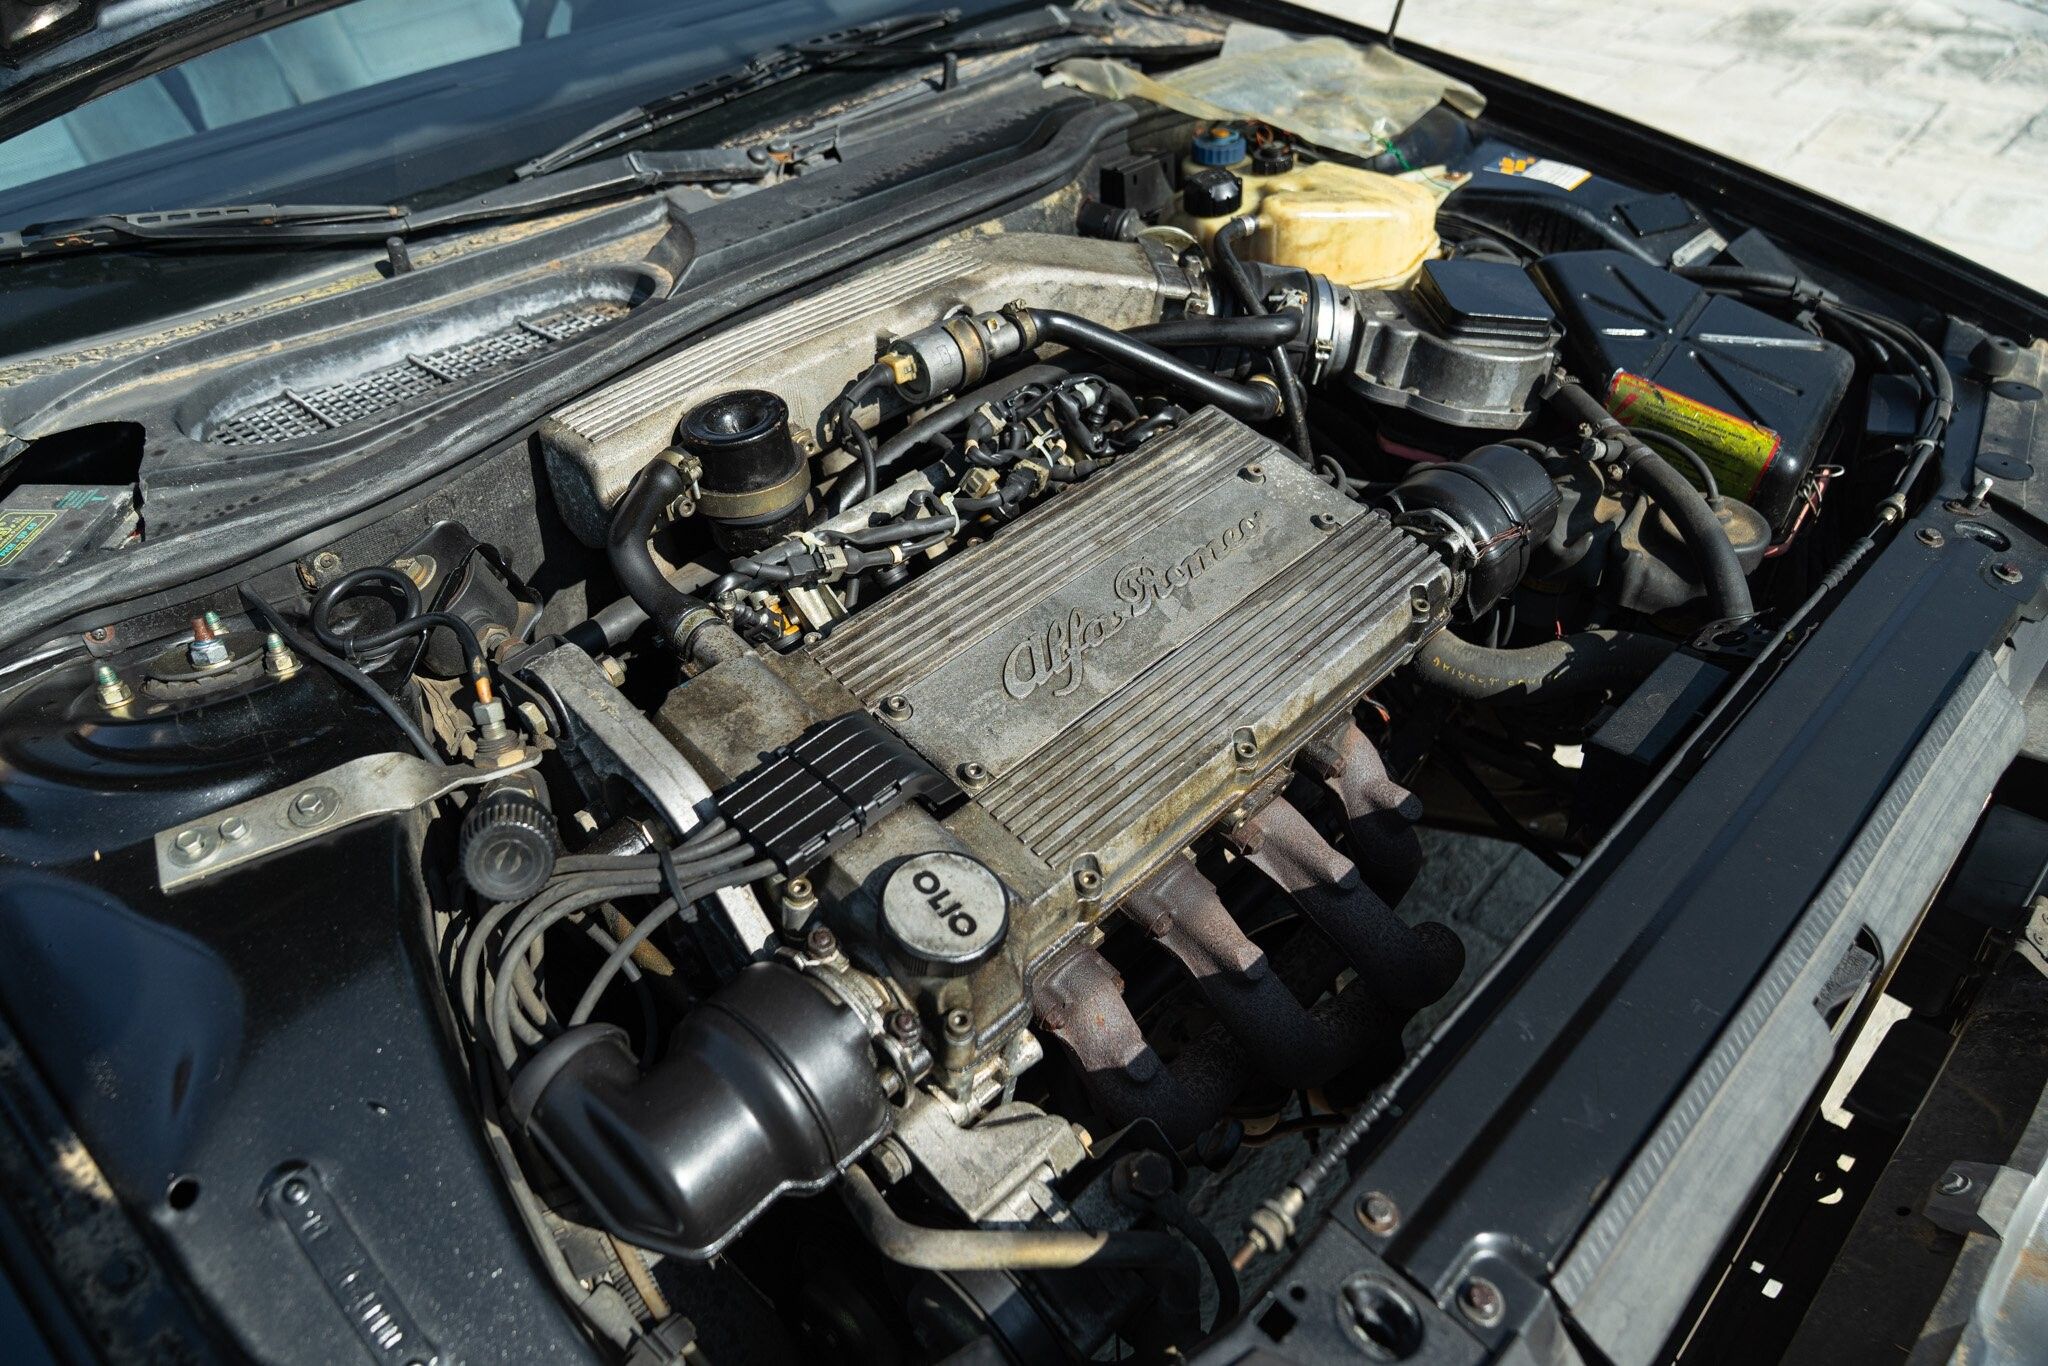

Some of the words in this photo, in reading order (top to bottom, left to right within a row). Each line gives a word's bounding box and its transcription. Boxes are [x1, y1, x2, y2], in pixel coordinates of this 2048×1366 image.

[1003, 607, 1125, 700] Alfa
[1114, 511, 1262, 617] Romeo
[912, 870, 978, 937] OLIO
